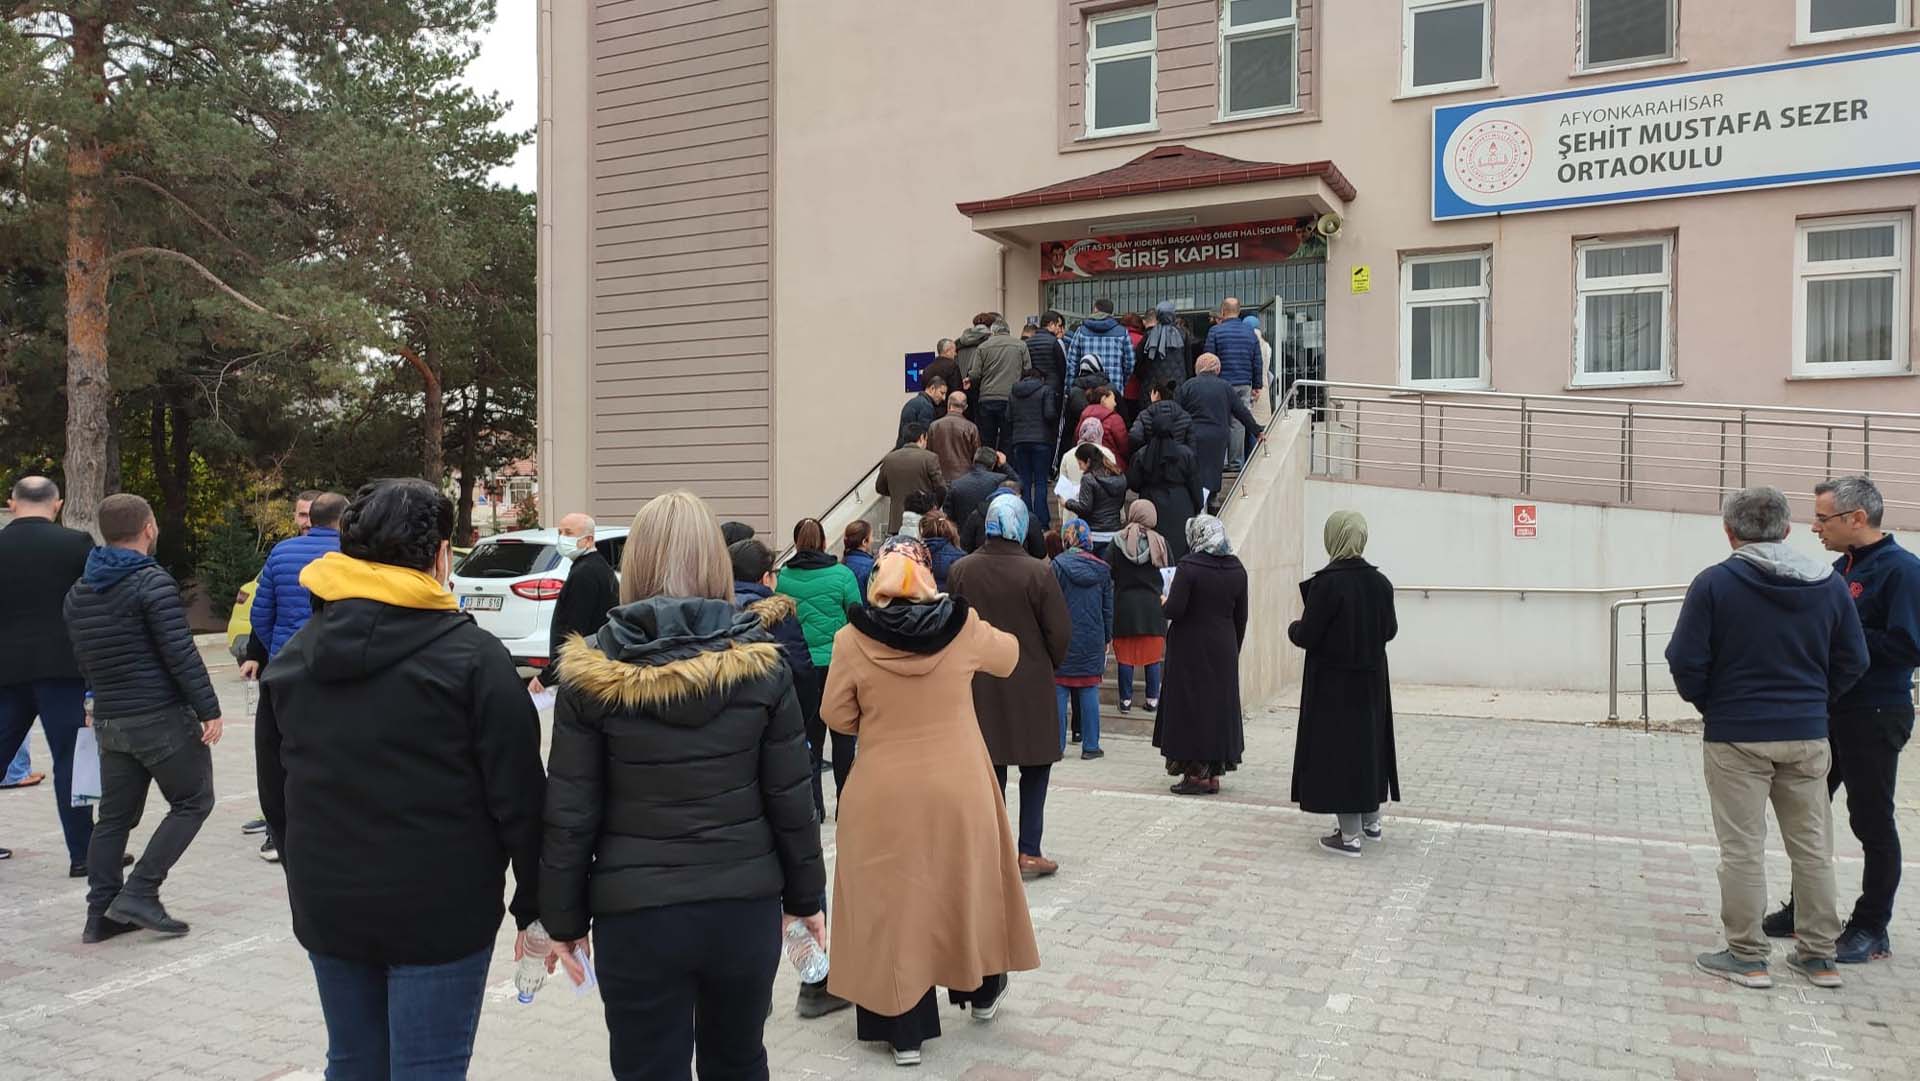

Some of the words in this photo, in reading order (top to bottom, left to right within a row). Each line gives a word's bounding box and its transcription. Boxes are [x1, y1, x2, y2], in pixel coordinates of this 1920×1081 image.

[1559, 93, 1724, 127] AFYONKARAHİSAR
[1558, 124, 1632, 160] ŞEHİT
[1639, 110, 1772, 146] MUSTAFA
[1780, 99, 1868, 129] SEZER
[1557, 145, 1723, 184] ORTAOKULU
[1093, 240, 1133, 252] ASTSUBAY
[1134, 236, 1167, 248] KIDEMLİ
[1168, 232, 1212, 245] BAŞÇAVUŞ
[1213, 230, 1239, 240] ÖMER
[1119, 247, 1169, 268] GİRİŞ
[1174, 241, 1240, 264] KAPISI
